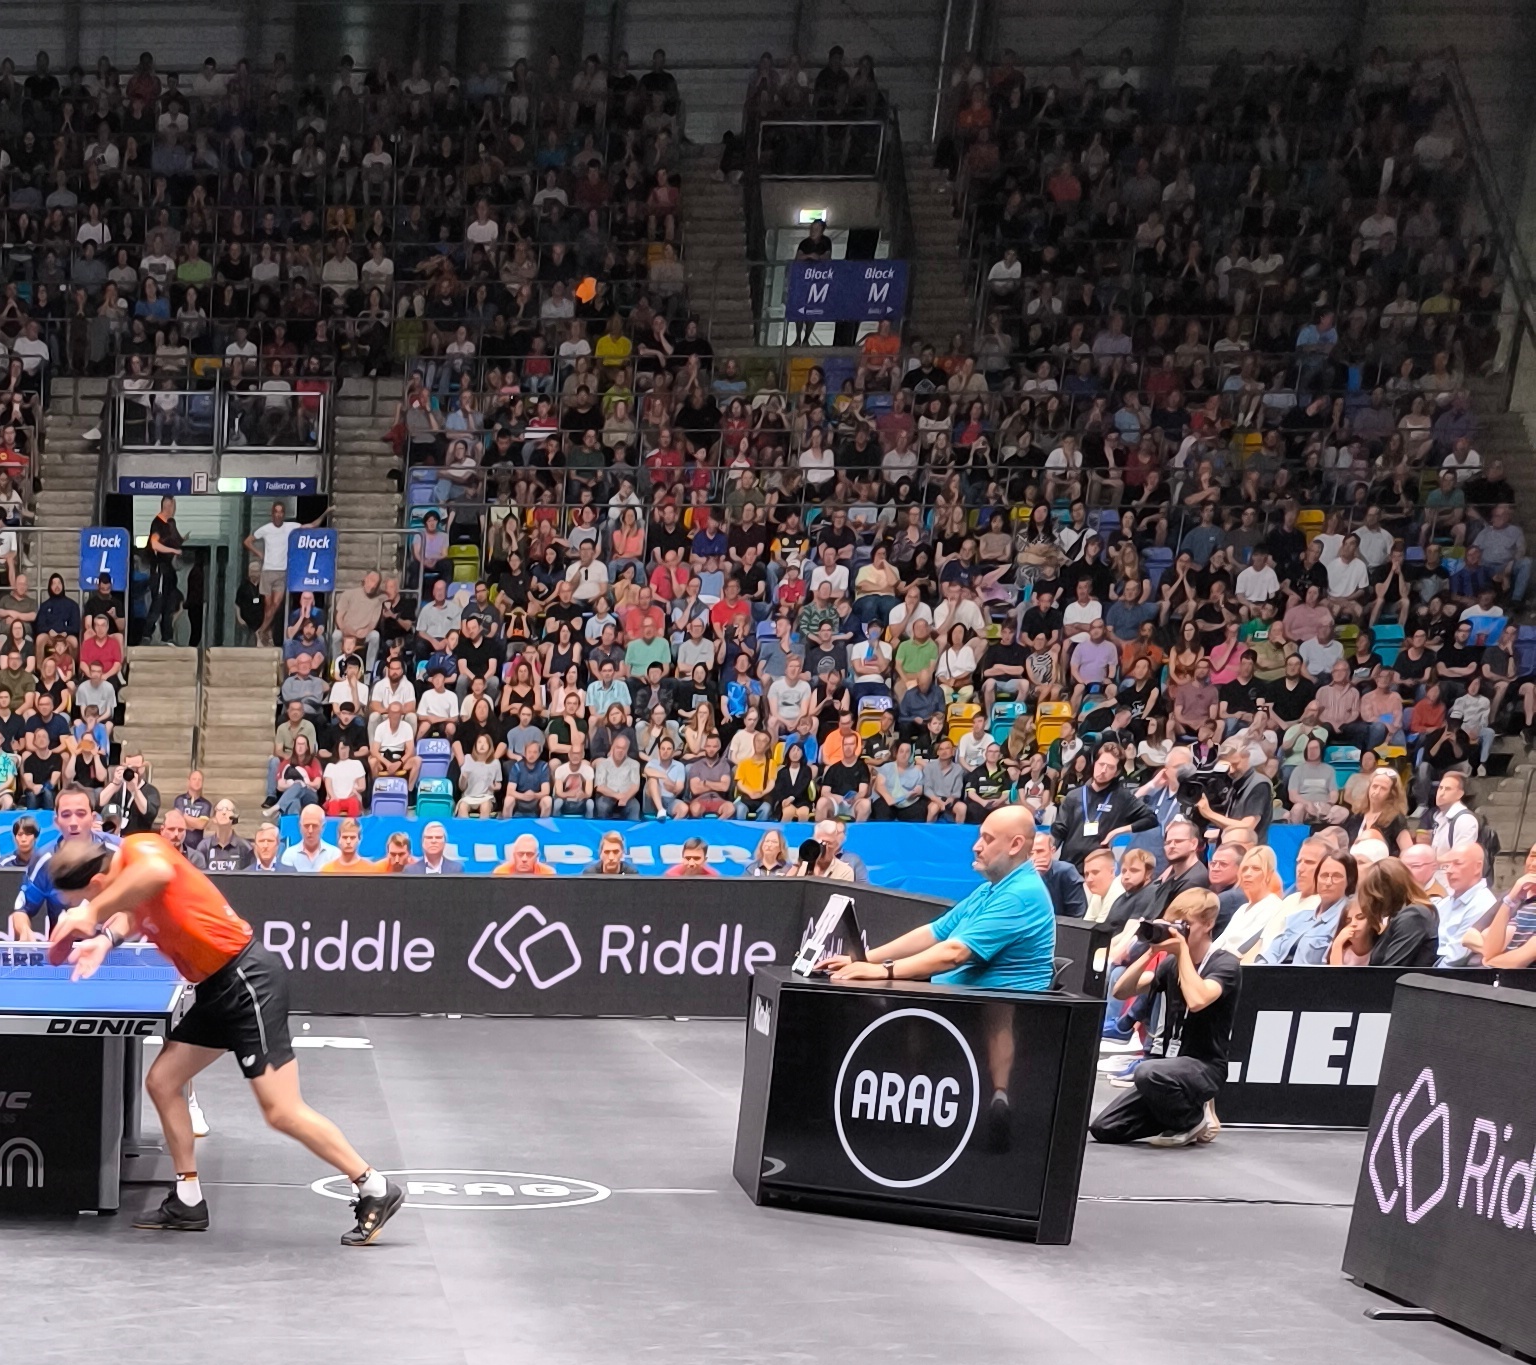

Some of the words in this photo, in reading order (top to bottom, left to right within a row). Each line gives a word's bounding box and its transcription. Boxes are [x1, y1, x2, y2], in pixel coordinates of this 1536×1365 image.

[804, 267, 834, 280] Block
[864, 267, 895, 280] Block
[807, 283, 830, 304] M
[867, 282, 890, 303] M
[89, 534, 122, 548] Block
[297, 535, 331, 549] Block
[99, 550, 111, 573] L
[307, 551, 320, 574] L
[263, 919, 435, 973] Riddle
[599, 923, 777, 976] Riddle
[46, 1018, 158, 1036] DONIC
[851, 1069, 960, 1128] ARAG
[352, 1180, 572, 1198] RAG
